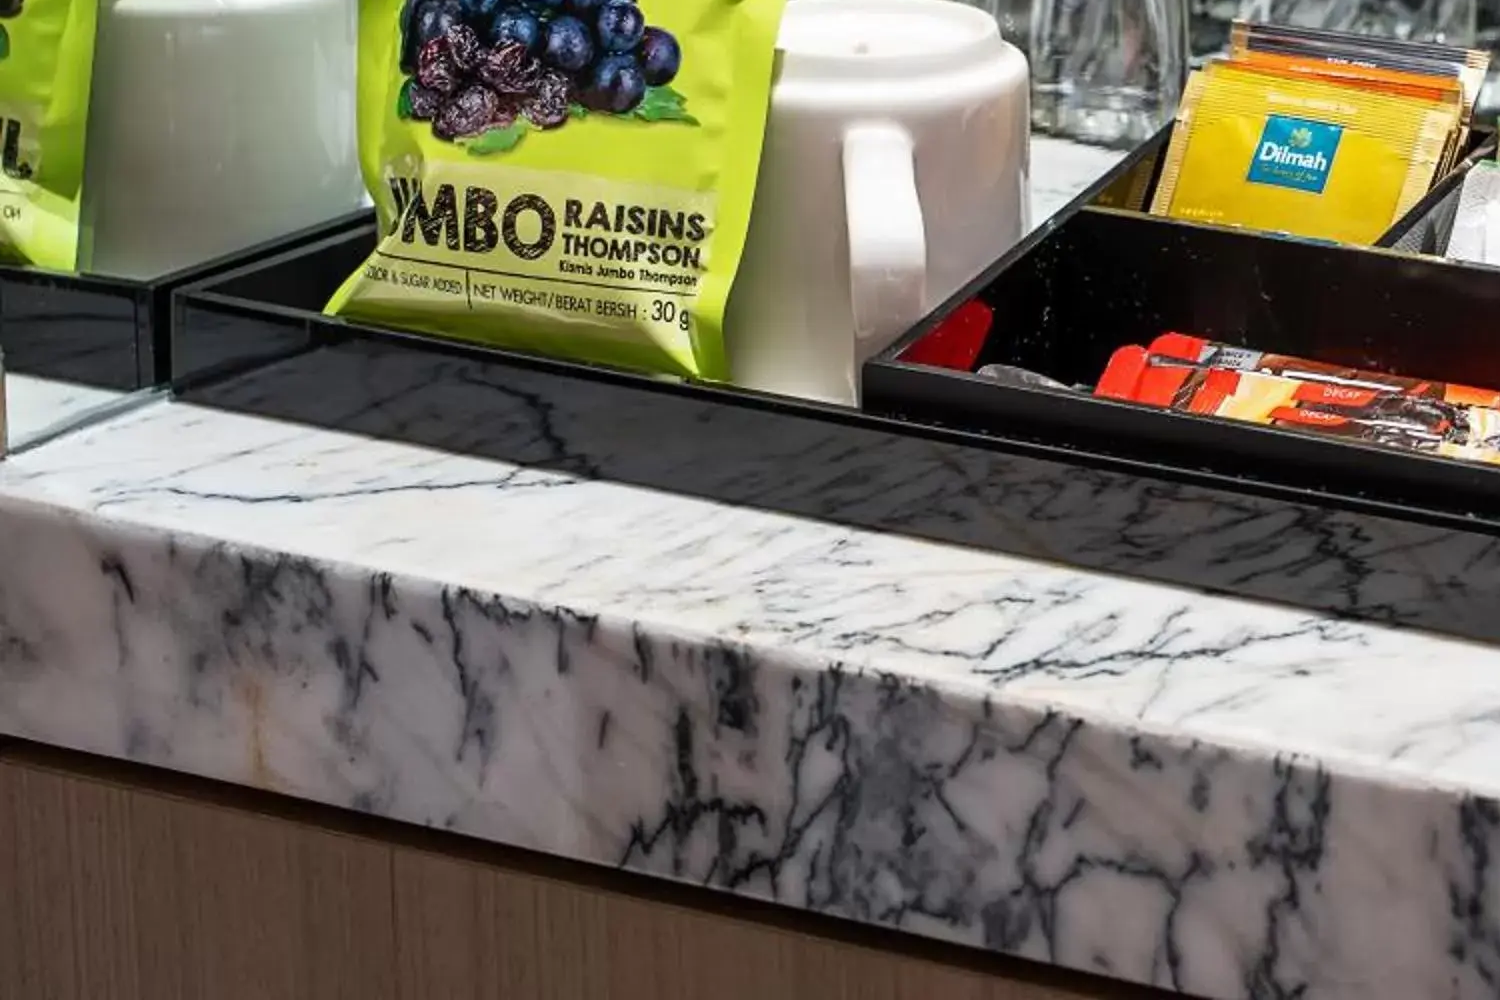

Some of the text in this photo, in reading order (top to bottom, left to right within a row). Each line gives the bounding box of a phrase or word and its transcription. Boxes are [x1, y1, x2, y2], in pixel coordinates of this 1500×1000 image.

[1259, 141, 1327, 172] Dilmah
[564, 199, 706, 242] RAISINS
[561, 233, 702, 269] THOMPSON
[401, 270, 431, 291] SUGAR
[432, 277, 463, 296] ADDED
[559, 259, 698, 287] Kismis Jumbo Thompson
[473, 283, 497, 300] NET
[596, 298, 637, 320] BERSIH
[651, 299, 675, 324] 30
[679, 309, 690, 331] g
